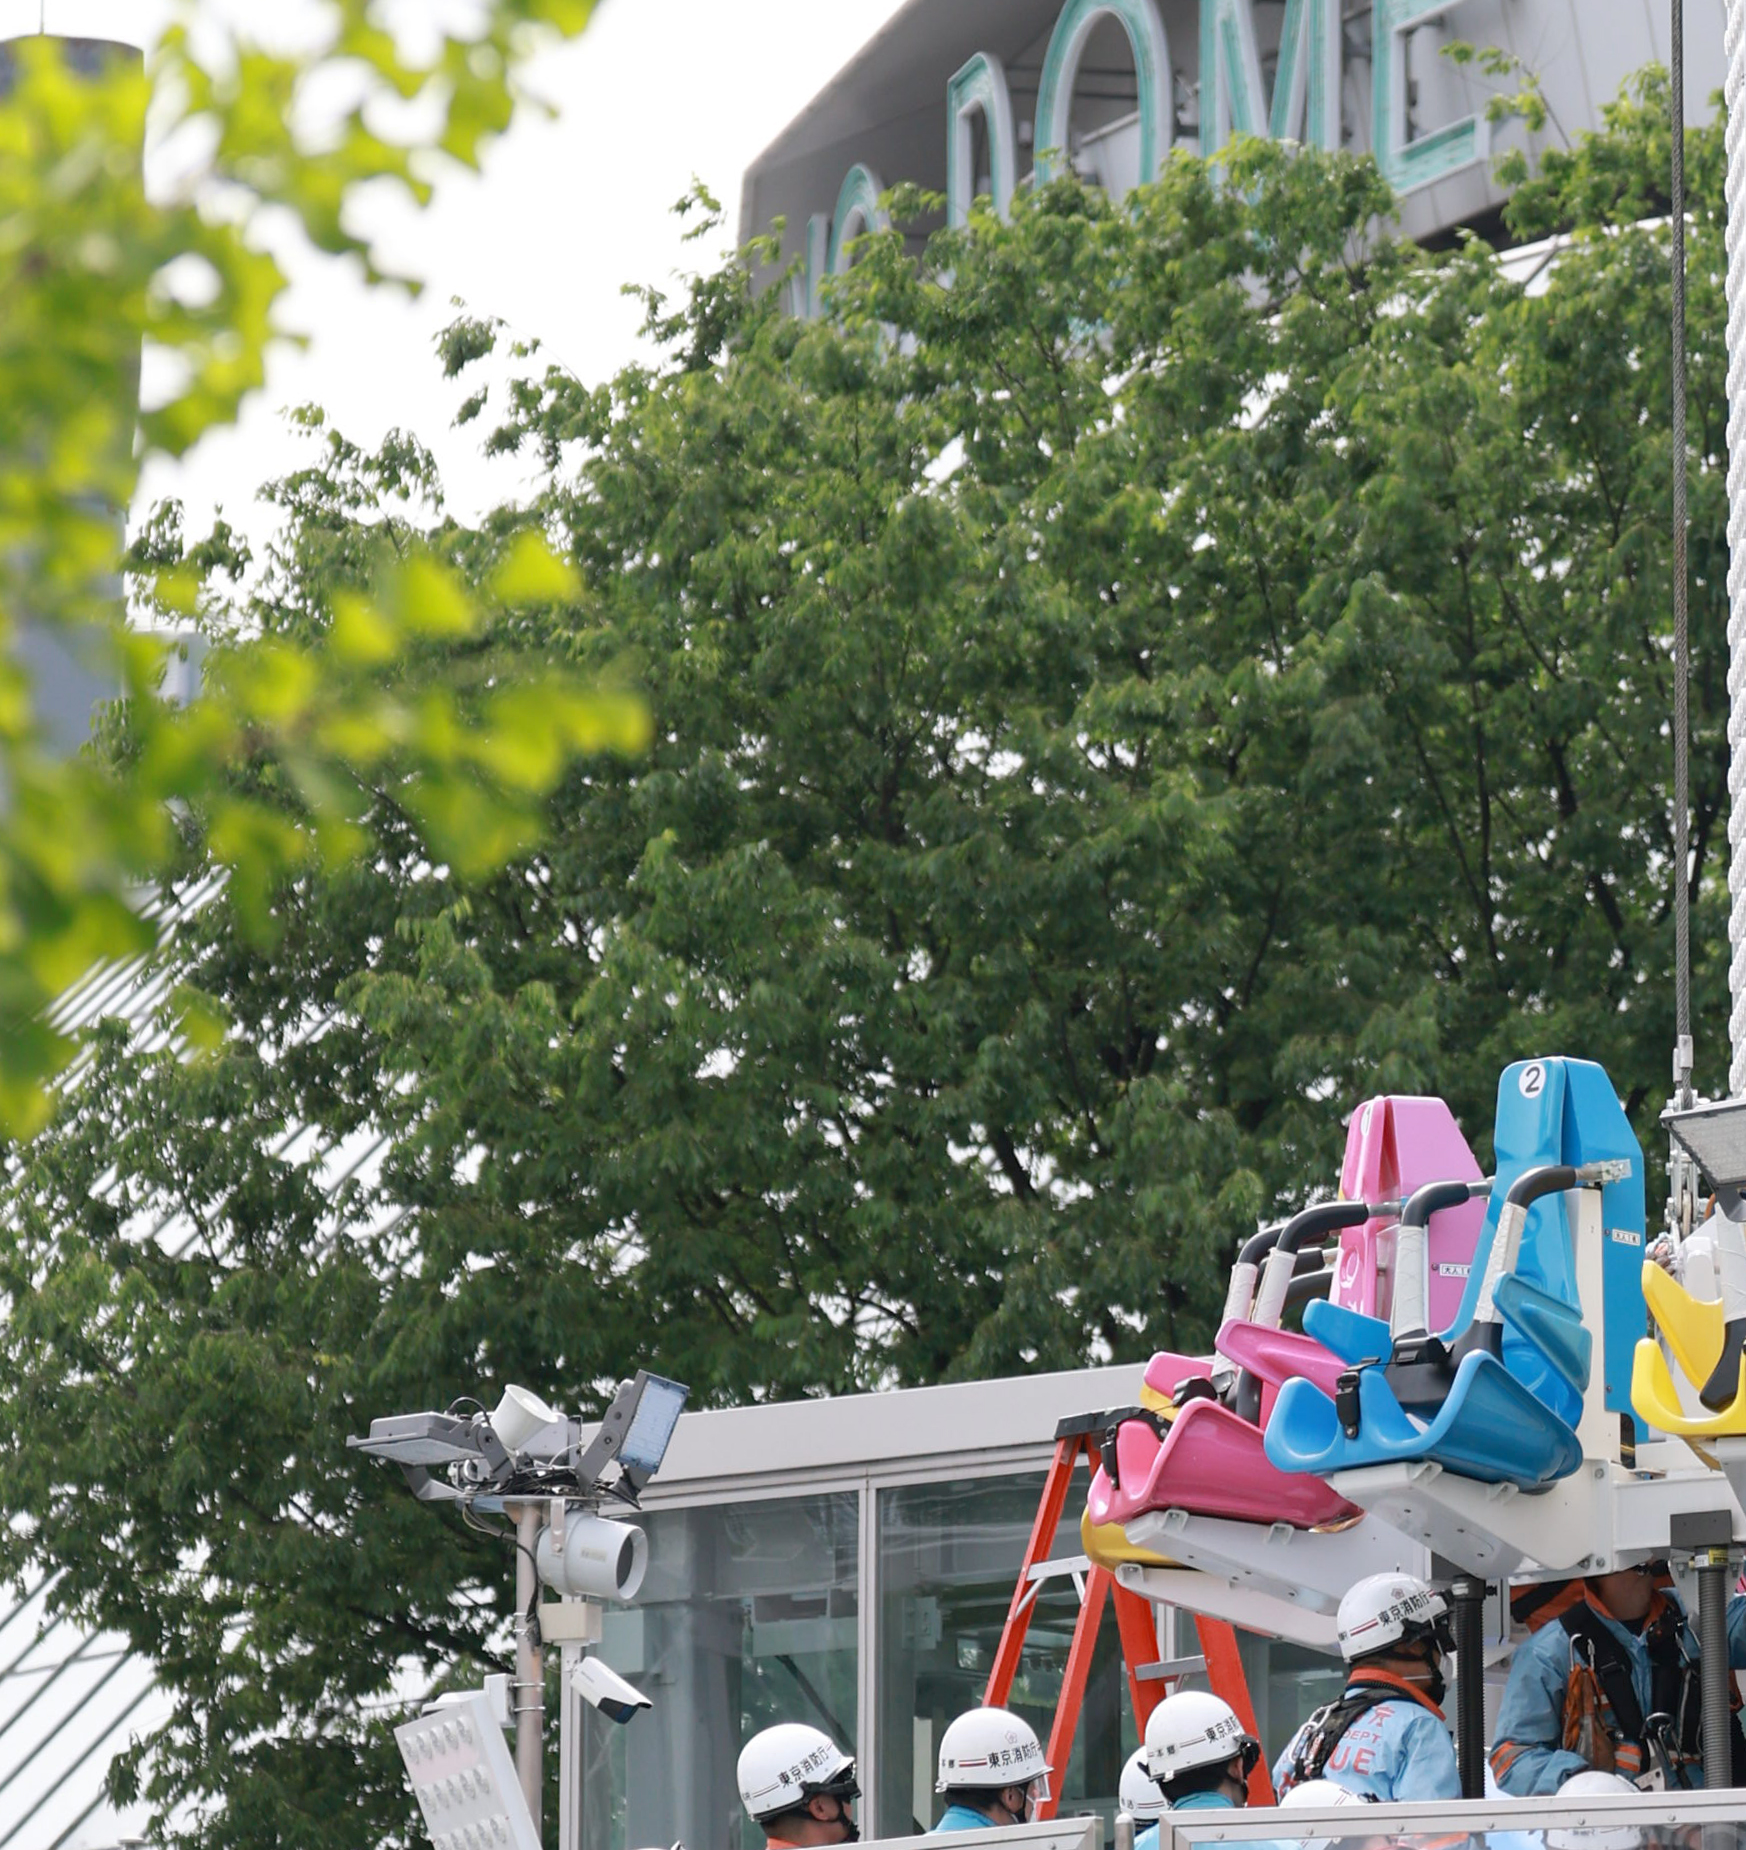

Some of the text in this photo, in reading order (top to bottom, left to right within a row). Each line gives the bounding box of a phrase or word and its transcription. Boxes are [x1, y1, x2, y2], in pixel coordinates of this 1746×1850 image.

[1525, 1066, 1541, 1093] 2
[1378, 1591, 1430, 1628] 東京消防庁
[776, 1746, 830, 1790] 東京消防庁
[987, 1741, 1039, 1770] 東京消防庁
